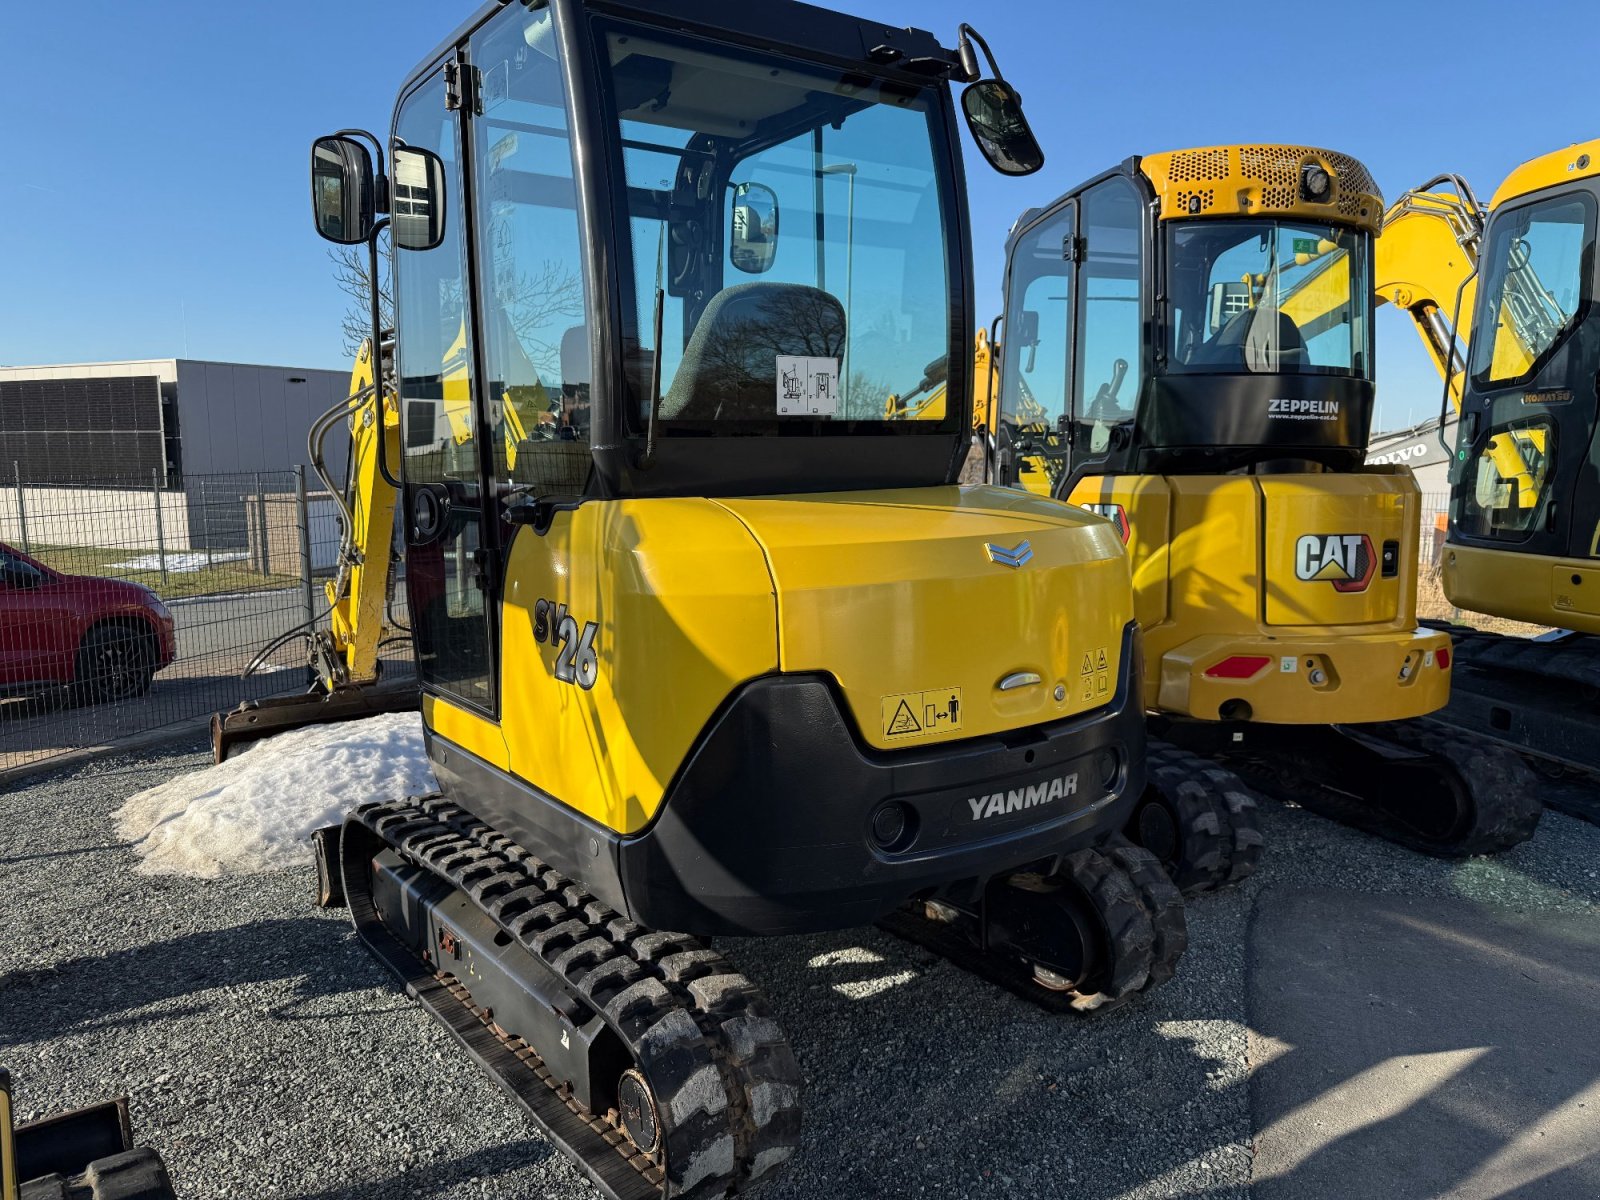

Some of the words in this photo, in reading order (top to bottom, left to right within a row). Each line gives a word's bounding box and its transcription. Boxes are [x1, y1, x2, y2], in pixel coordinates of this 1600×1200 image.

[1268, 399, 1339, 414] ZEPPELIN
[1296, 534, 1362, 580] CAT
[968, 773, 1078, 820] YANMAR
